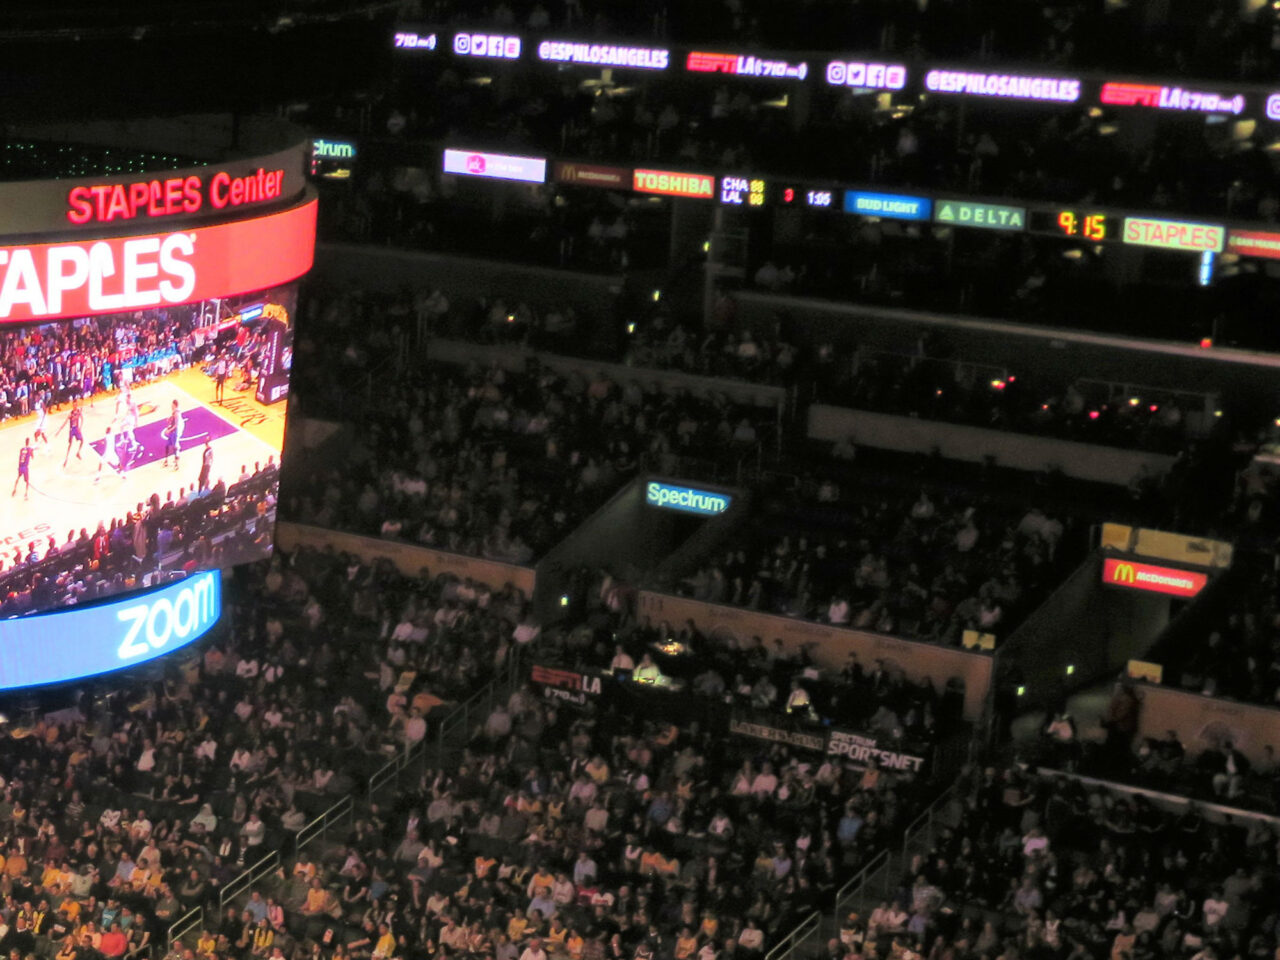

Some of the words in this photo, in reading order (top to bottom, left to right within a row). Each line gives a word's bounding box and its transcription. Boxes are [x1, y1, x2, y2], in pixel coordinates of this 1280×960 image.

[539, 41, 669, 69] @ESPNLOSANGELES
[687, 52, 737, 74] ESPN
[925, 71, 1080, 101] @ESPNLOSANGELES
[1101, 82, 1160, 107] ESPN
[67, 177, 203, 223] STAPLES
[210, 168, 284, 208] Center
[635, 172, 712, 194] TOSHIBA
[722, 178, 748, 191] CHA
[721, 191, 742, 203] LAL
[856, 197, 882, 211] BUD
[882, 201, 919, 215] LIGHT
[959, 206, 1022, 227] DELTA
[1058, 211, 1105, 241] 9:15
[1126, 219, 1219, 249] STAPLES
[647, 482, 726, 512] Spectrum
[119, 573, 216, 660] zoom
[582, 675, 601, 694] LA
[831, 731, 877, 748] SPECTRUM
[827, 740, 925, 772] SPORTSNET
